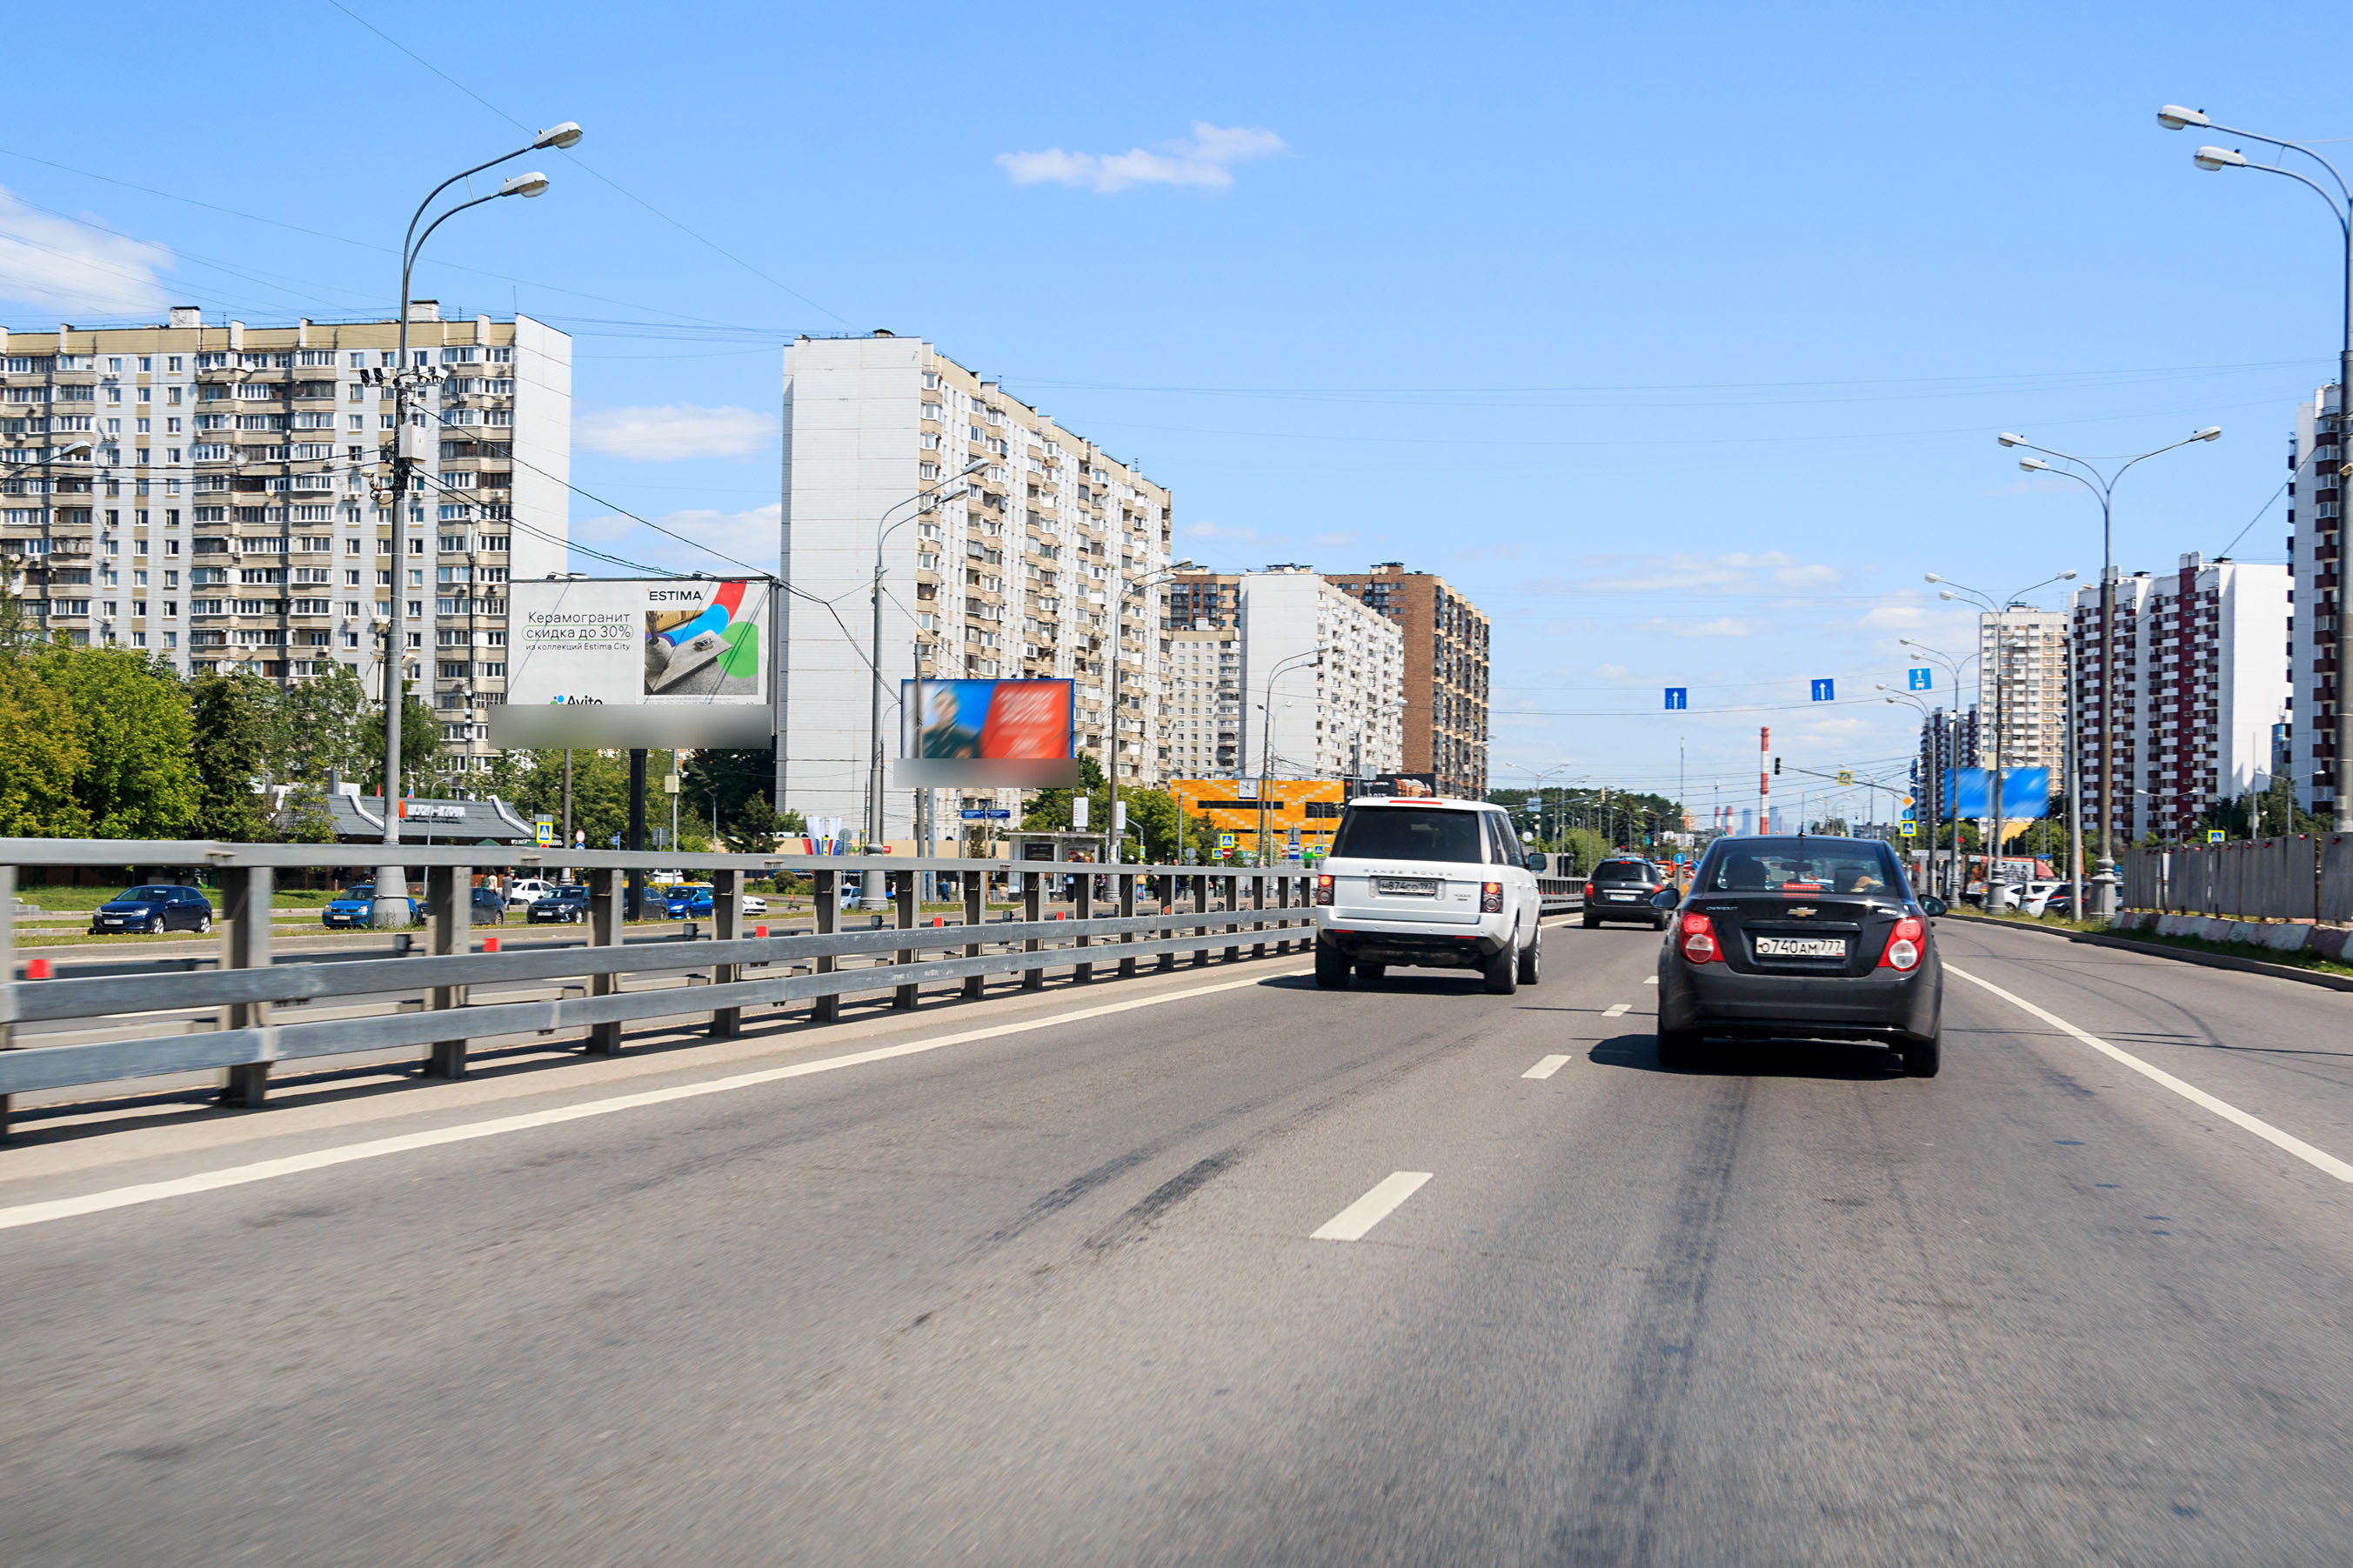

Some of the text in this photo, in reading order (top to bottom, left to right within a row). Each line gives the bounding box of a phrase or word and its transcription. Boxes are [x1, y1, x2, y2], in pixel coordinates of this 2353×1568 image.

[649, 591, 703, 601] ESTIMA
[528, 611, 631, 626] Керамогранит
[526, 625, 632, 640] скидка до 30%
[538, 643, 583, 651] коллекций
[614, 643, 631, 651] City
